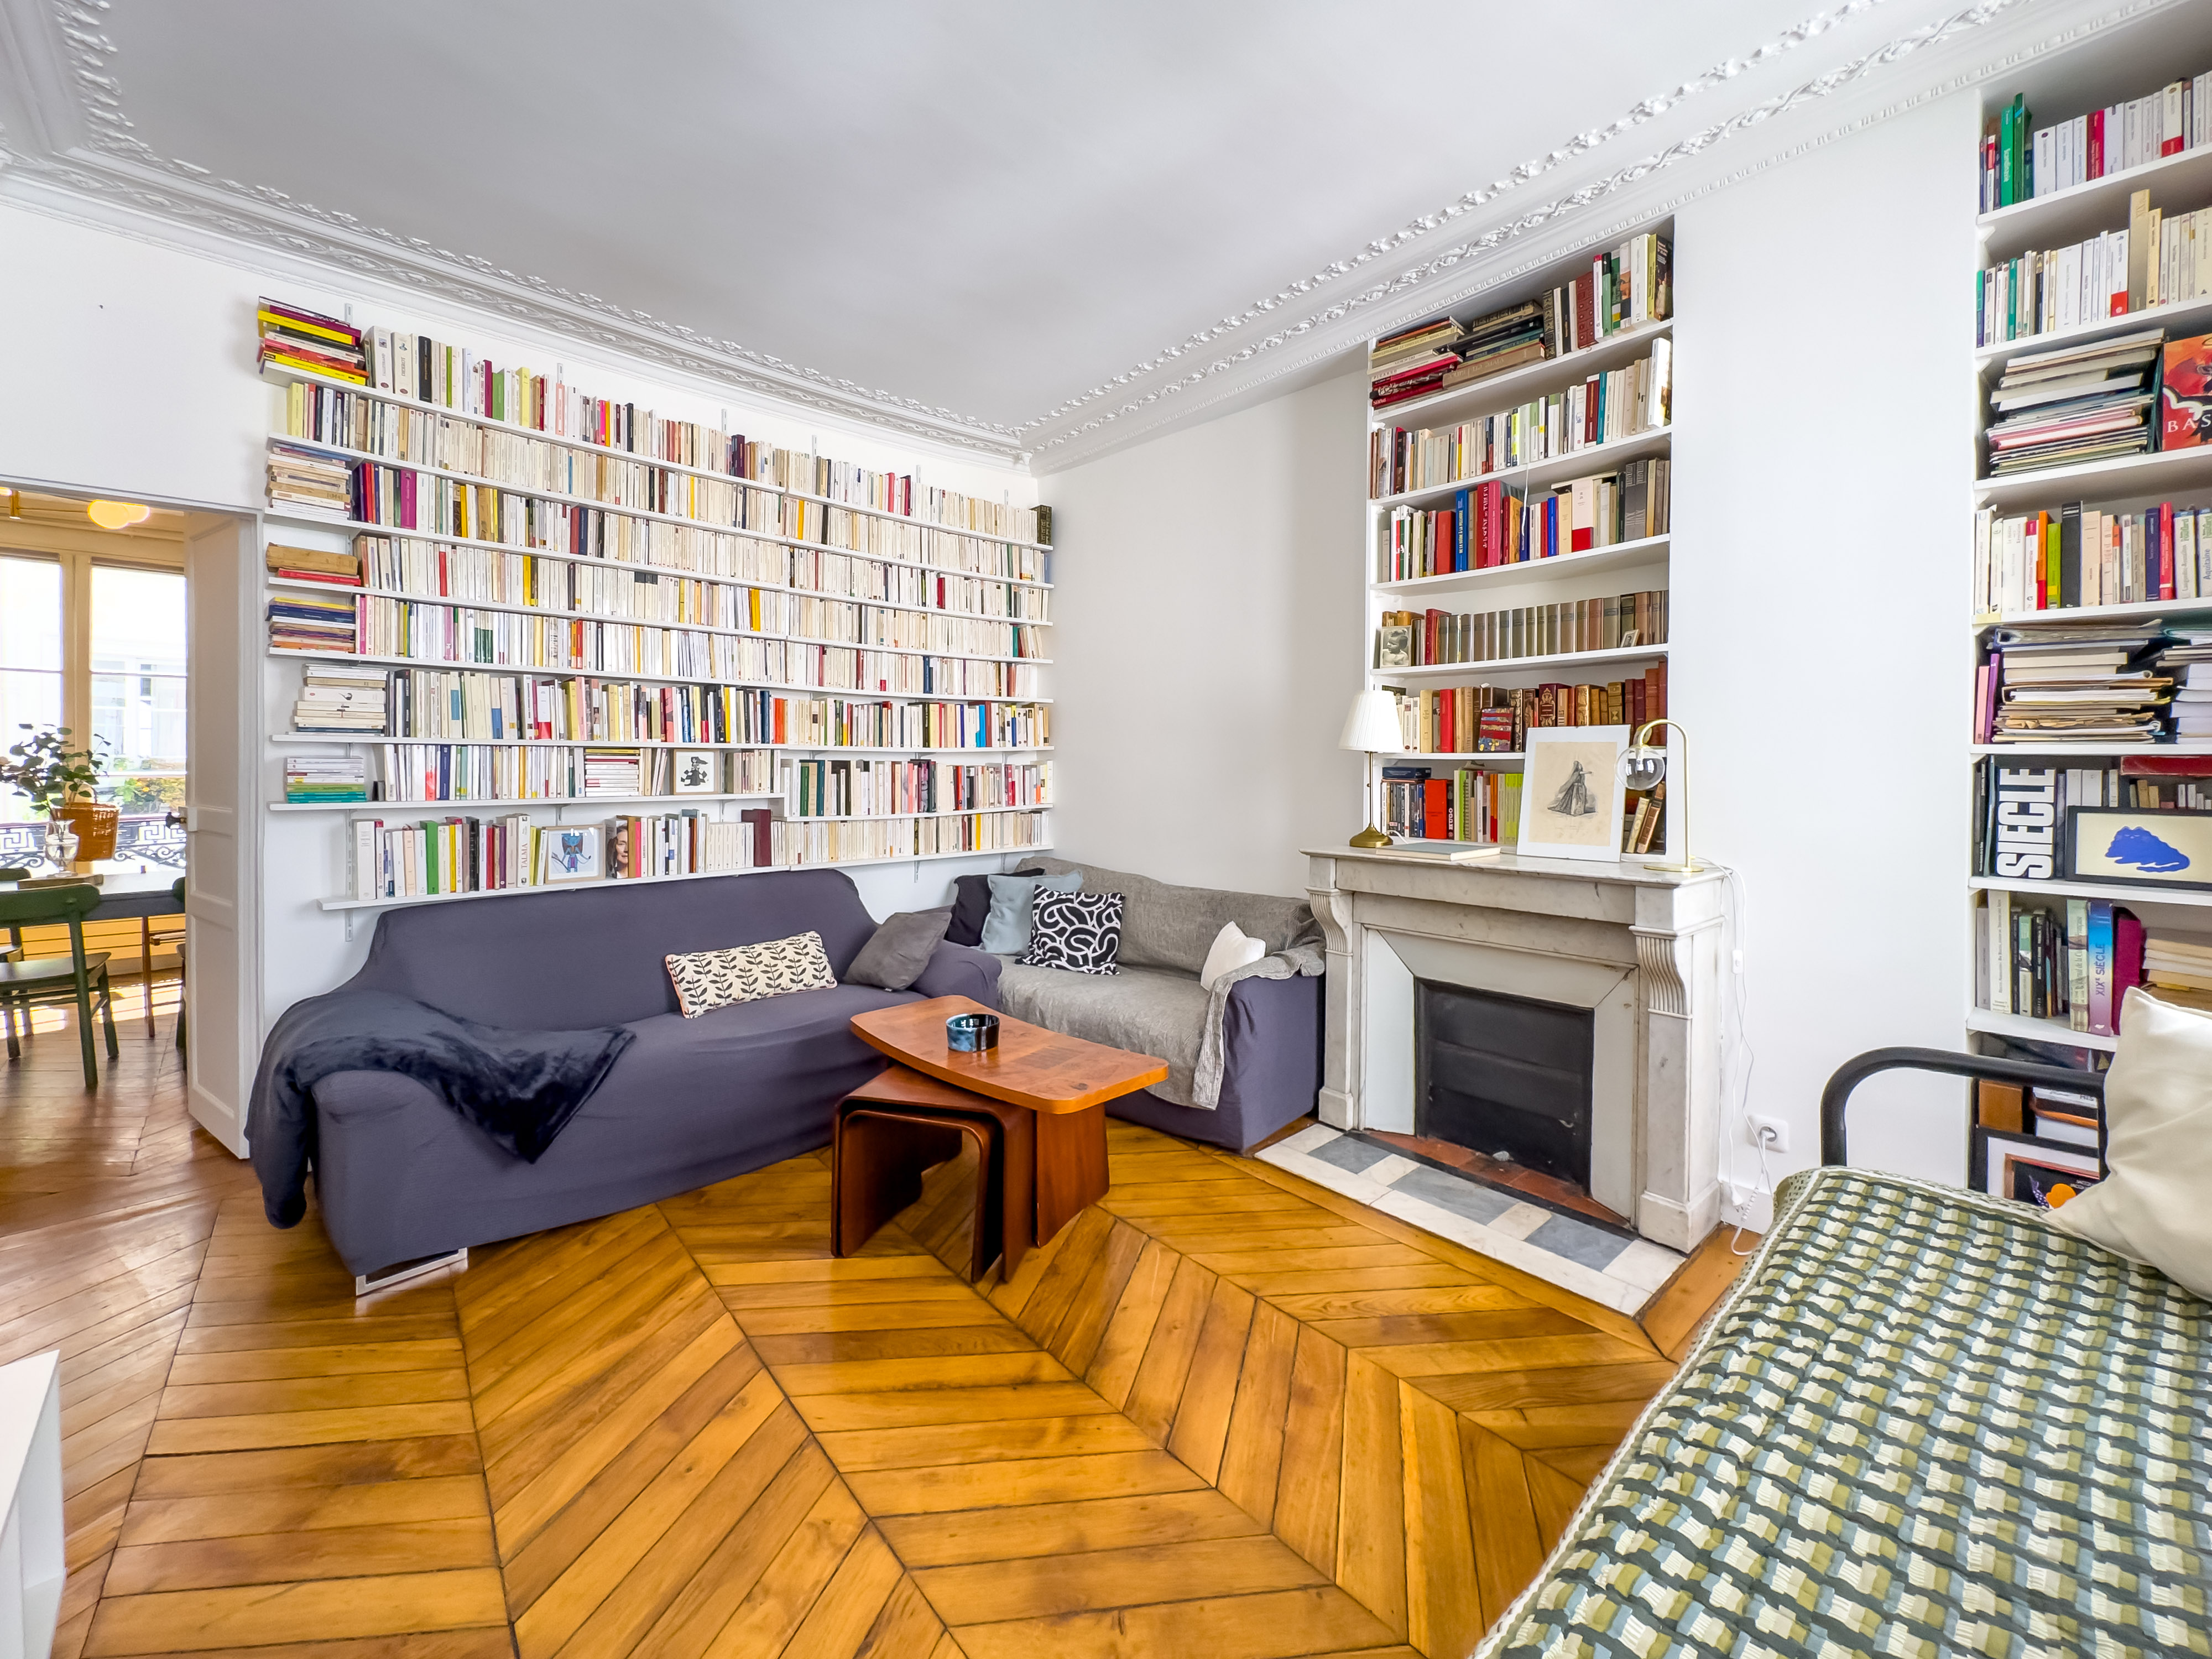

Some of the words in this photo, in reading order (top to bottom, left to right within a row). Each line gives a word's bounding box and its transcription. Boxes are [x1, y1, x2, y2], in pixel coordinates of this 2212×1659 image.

[2203, 549, 2211, 580] Aquitaine
[1996, 769, 2056, 879] SIECLE
[2094, 943, 2105, 975] SIÈCLE
